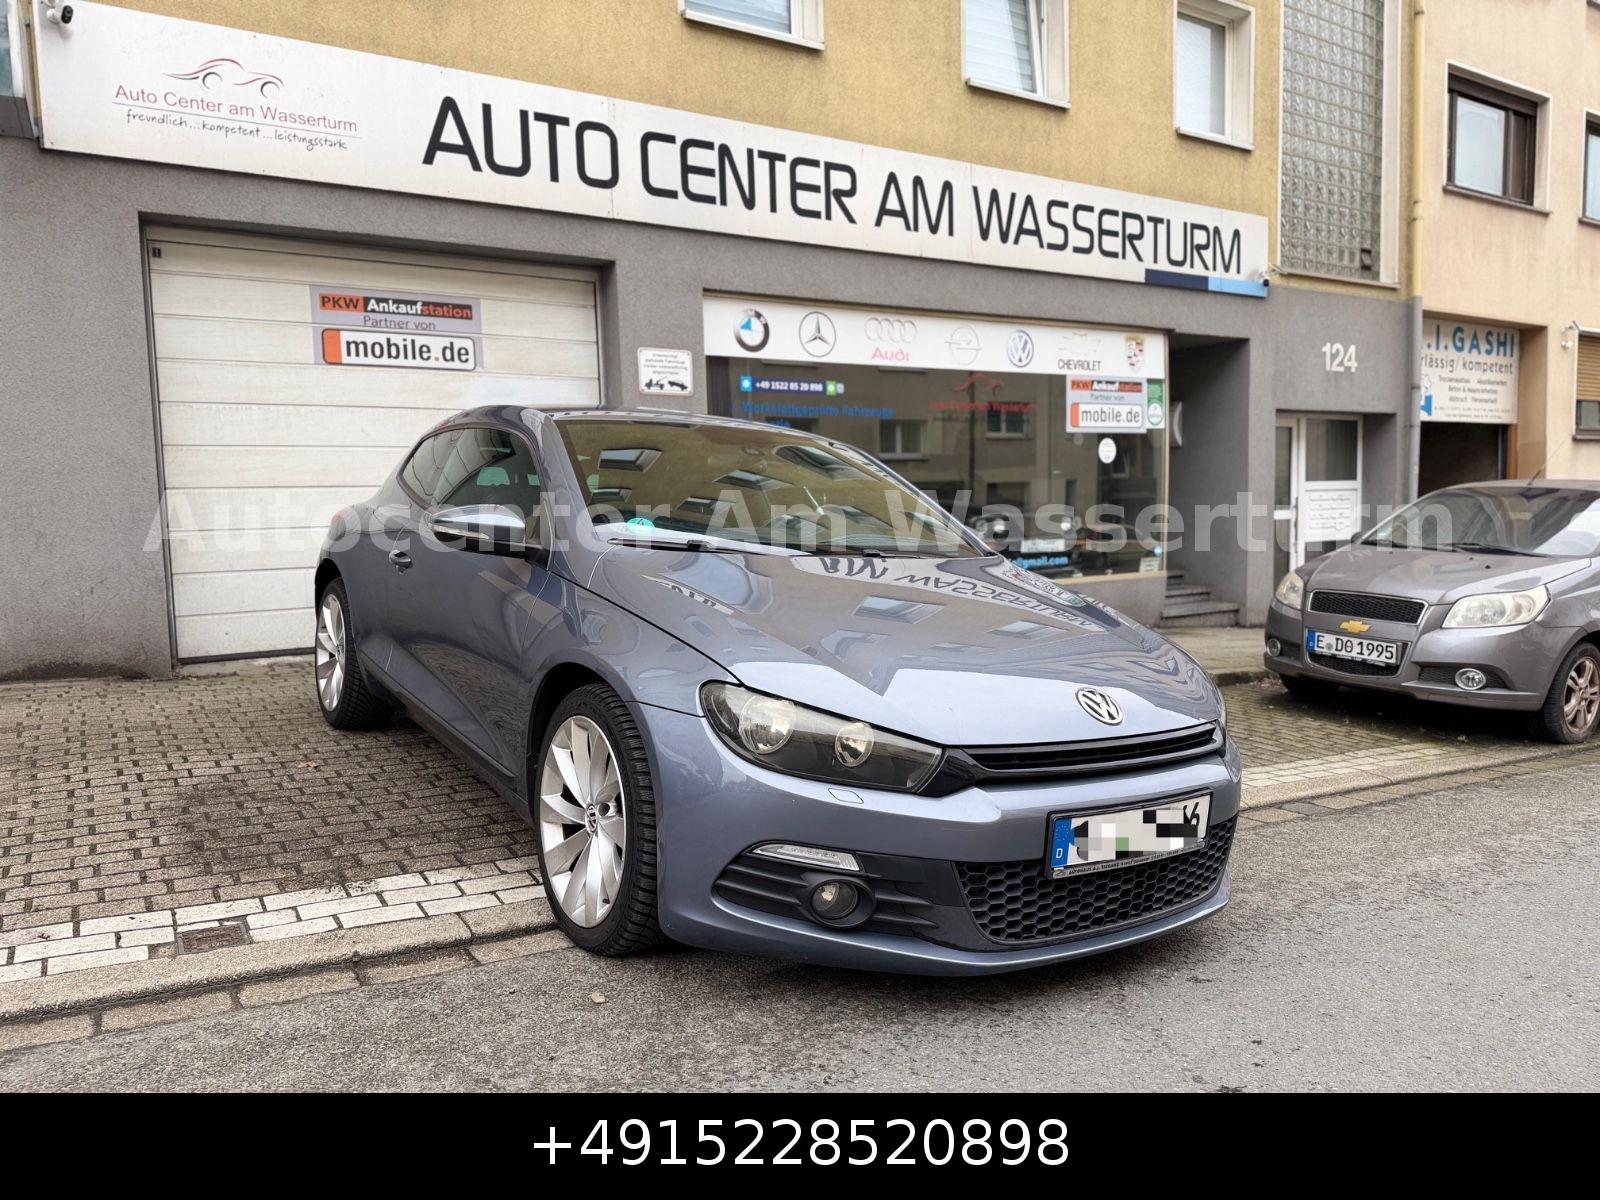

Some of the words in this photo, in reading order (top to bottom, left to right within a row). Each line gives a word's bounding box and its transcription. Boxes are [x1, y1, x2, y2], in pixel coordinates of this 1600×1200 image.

[115, 84, 158, 104] Auto
[164, 91, 223, 113] Center
[229, 104, 255, 118] am
[260, 105, 358, 132] Wasserturm
[422, 96, 620, 190] AUTO
[640, 131, 857, 224] CENTER
[874, 171, 954, 237] AM
[973, 186, 1241, 275] WASSERTURM
[320, 295, 360, 309] PKW
[367, 299, 472, 318] Ankaufstation
[363, 315, 410, 328] Partner
[414, 321, 436, 331] von
[345, 337, 470, 364] mobile.de
[871, 346, 910, 362] Audi
[1321, 342, 1358, 373] 124
[1058, 358, 1102, 371] CHEVROLET
[1462, 356, 1513, 375] kompetent
[1071, 380, 1091, 390] PKW
[1081, 407, 1140, 423] mobile.de
[1316, 635, 1325, 649] E
[1356, 642, 1394, 660] 1995
[1055, 848, 1063, 858] D
